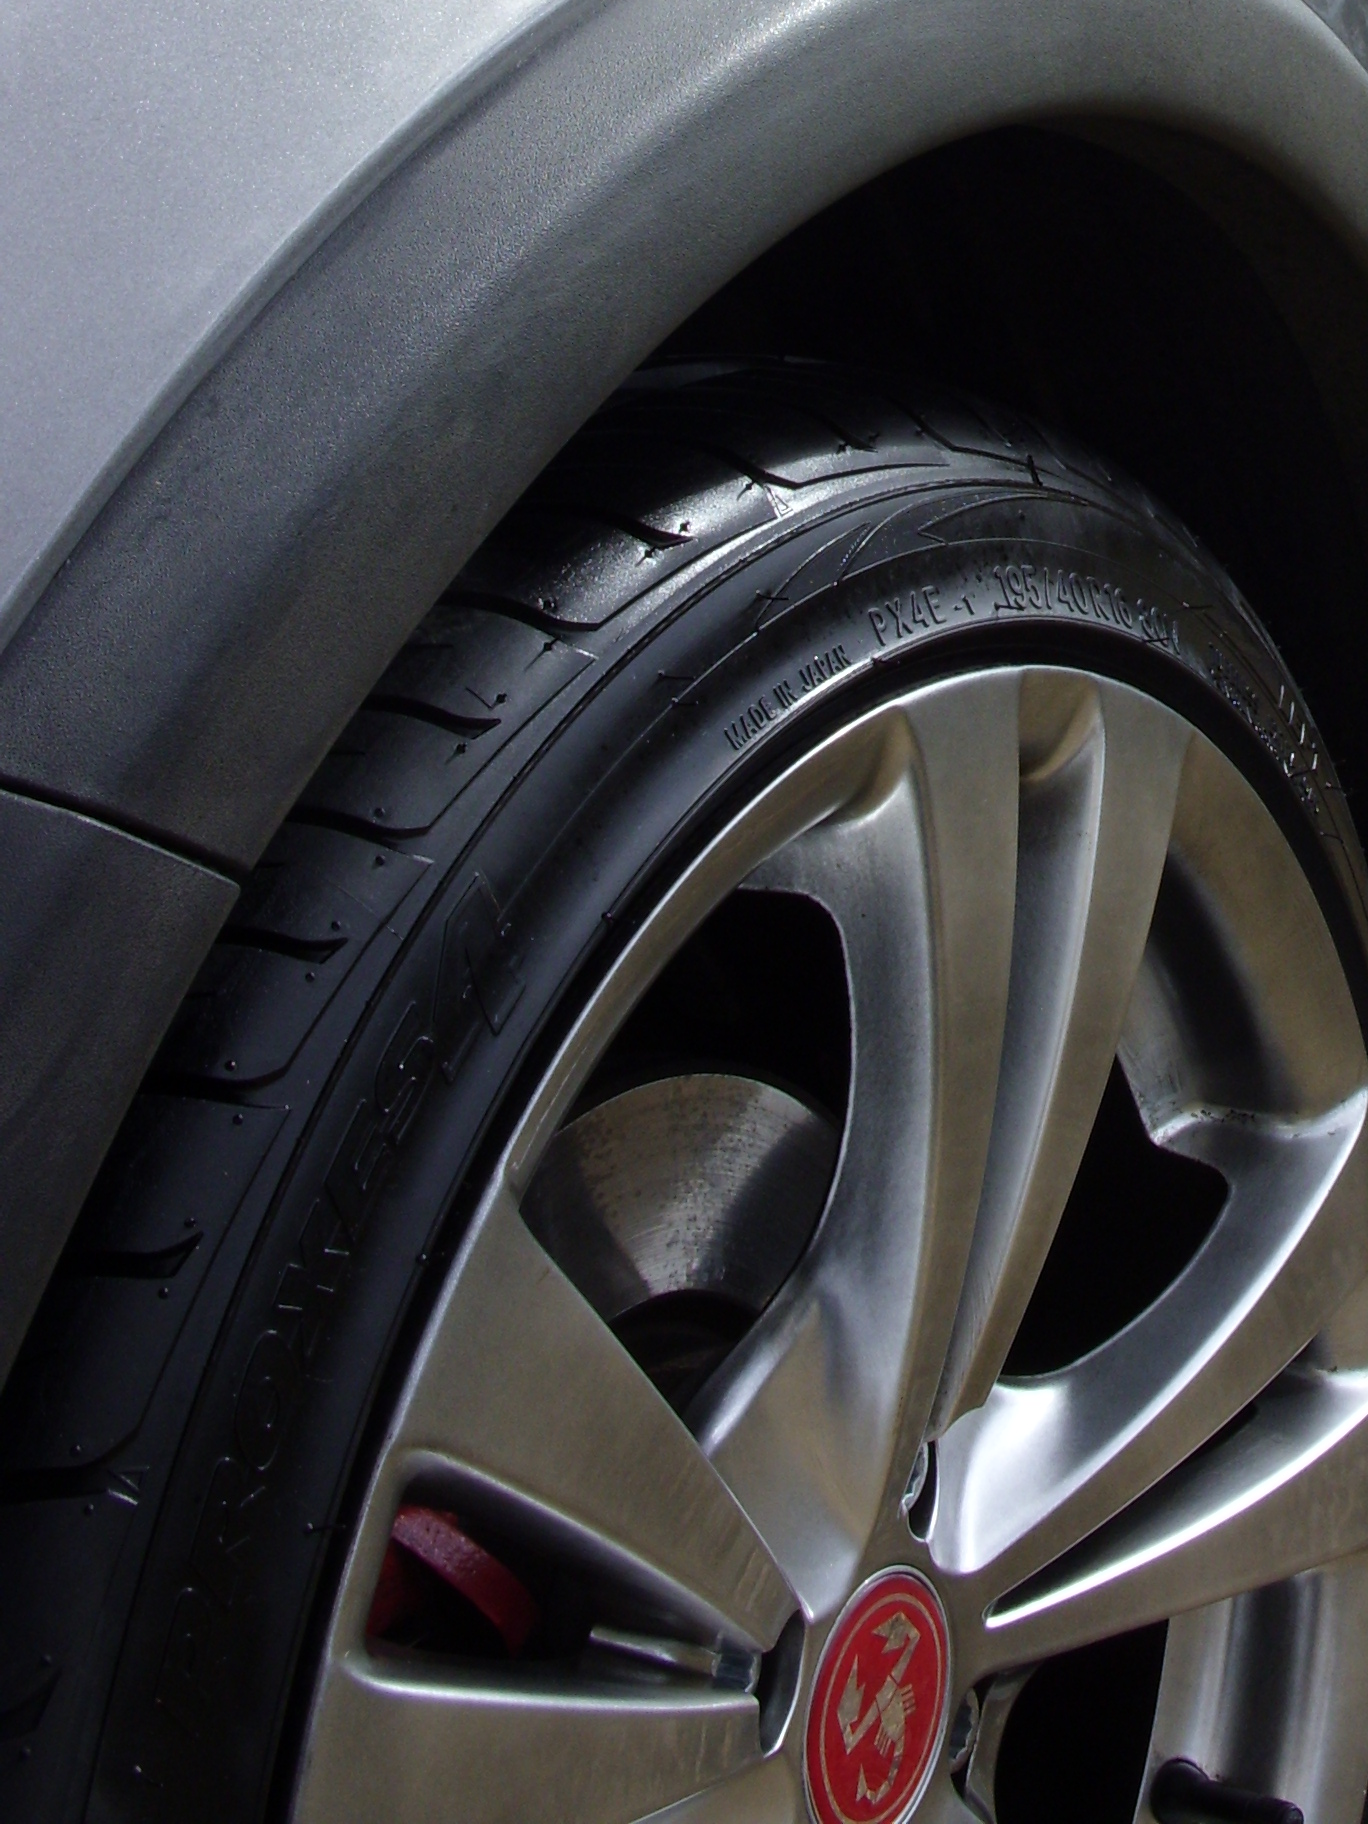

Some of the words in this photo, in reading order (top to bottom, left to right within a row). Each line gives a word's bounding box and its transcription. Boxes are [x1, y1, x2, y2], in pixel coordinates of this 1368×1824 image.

[867, 584, 948, 647] PX4E
[723, 694, 778, 751] MADE
[772, 679, 798, 710] IN
[799, 643, 853, 693] JAPAN
